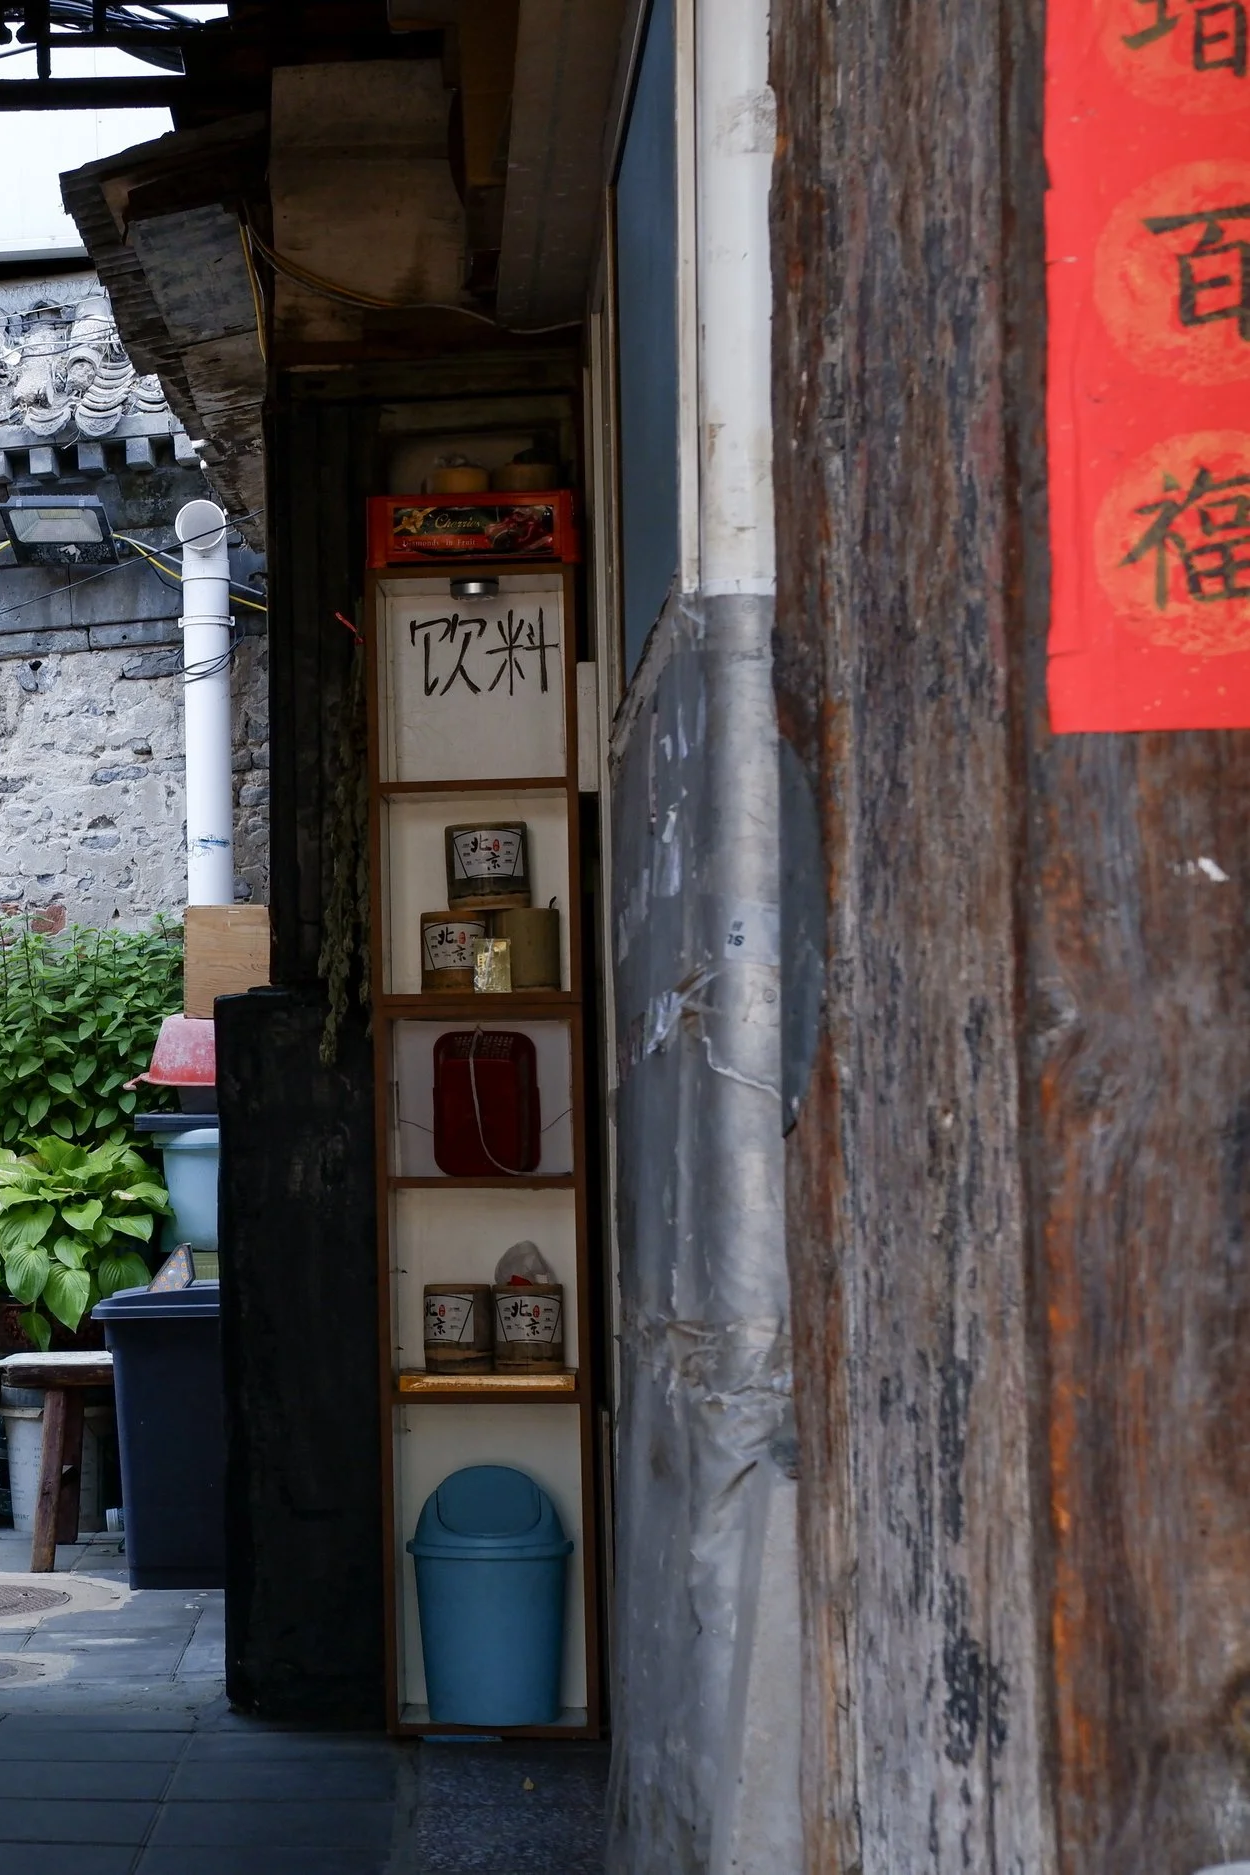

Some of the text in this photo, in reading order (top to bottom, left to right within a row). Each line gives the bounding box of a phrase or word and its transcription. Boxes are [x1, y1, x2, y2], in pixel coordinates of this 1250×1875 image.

[410, 606, 559, 696] 饮料
[470, 833, 501, 870] 北京
[438, 927, 466, 963] 北京
[511, 1300, 540, 1337] 北京
